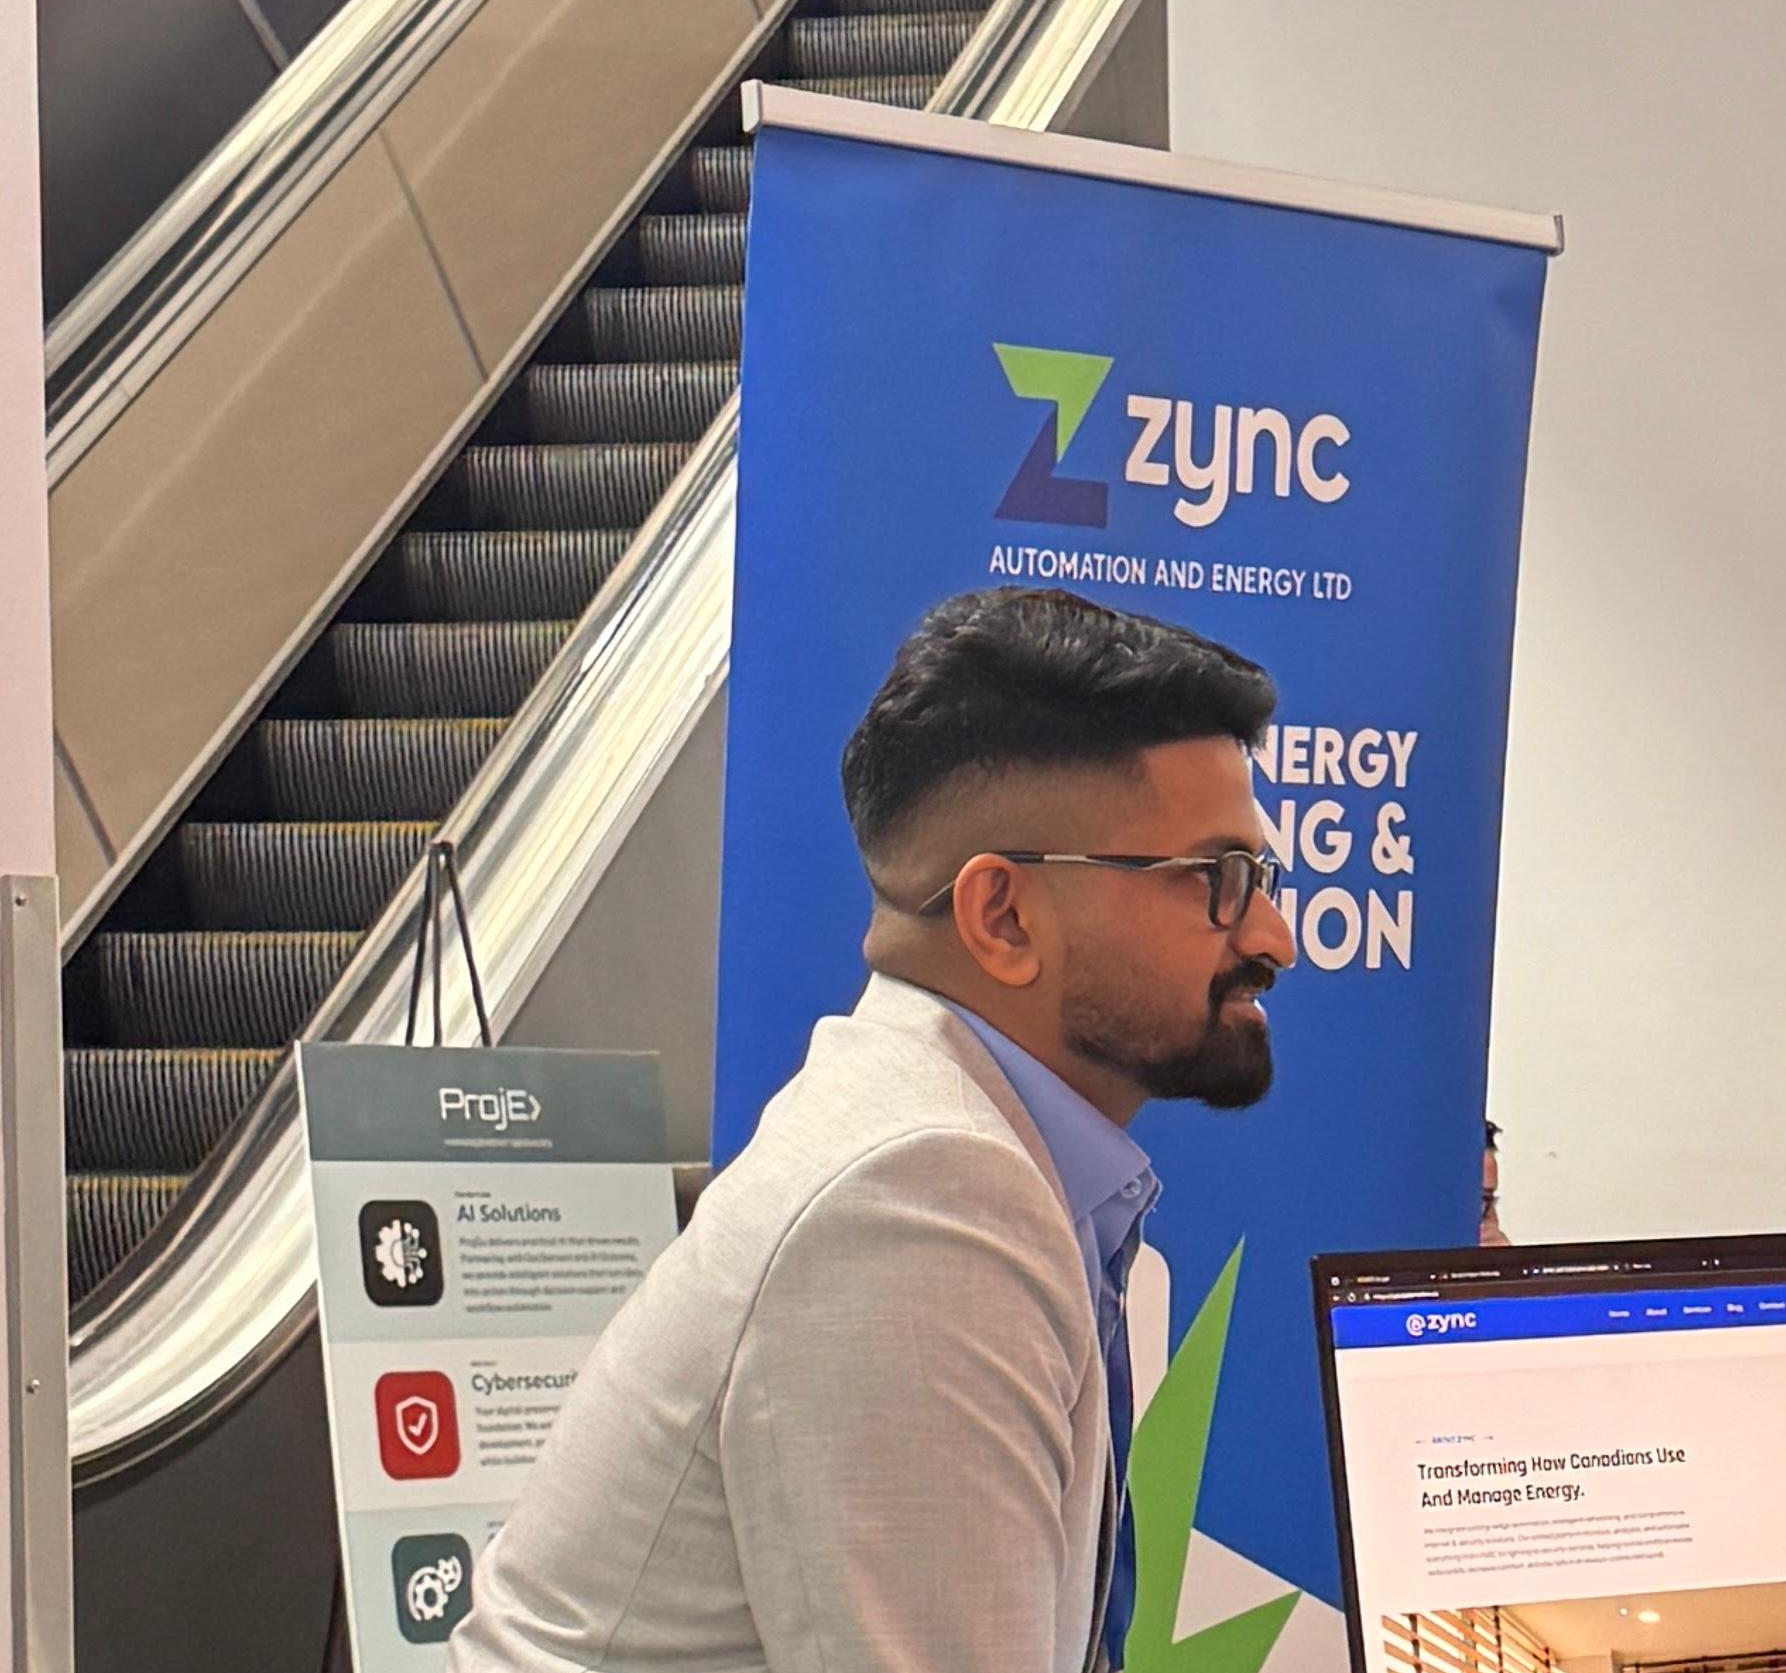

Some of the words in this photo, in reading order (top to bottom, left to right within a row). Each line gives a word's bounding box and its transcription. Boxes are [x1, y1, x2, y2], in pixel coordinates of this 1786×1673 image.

[1125, 394, 1352, 528] zync
[989, 545, 1146, 585] AUTOMATION
[1153, 559, 1204, 590] AND
[1211, 563, 1306, 597] ENERGY
[1313, 571, 1352, 601] LTD
[1251, 724, 1418, 788] NERGY
[1253, 799, 1353, 874] NG
[1371, 801, 1415, 874] &
[457, 1204, 475, 1222] AI
[480, 1203, 562, 1222] Solutions
[1417, 1457, 1528, 1481] Transforming
[1531, 1455, 1566, 1473] How
[1570, 1448, 1653, 1469] Canadians
[1656, 1446, 1686, 1464] Use
[1421, 1489, 1453, 1508] And
[1457, 1486, 1522, 1506] Manage
[1526, 1483, 1585, 1502] Energy.
